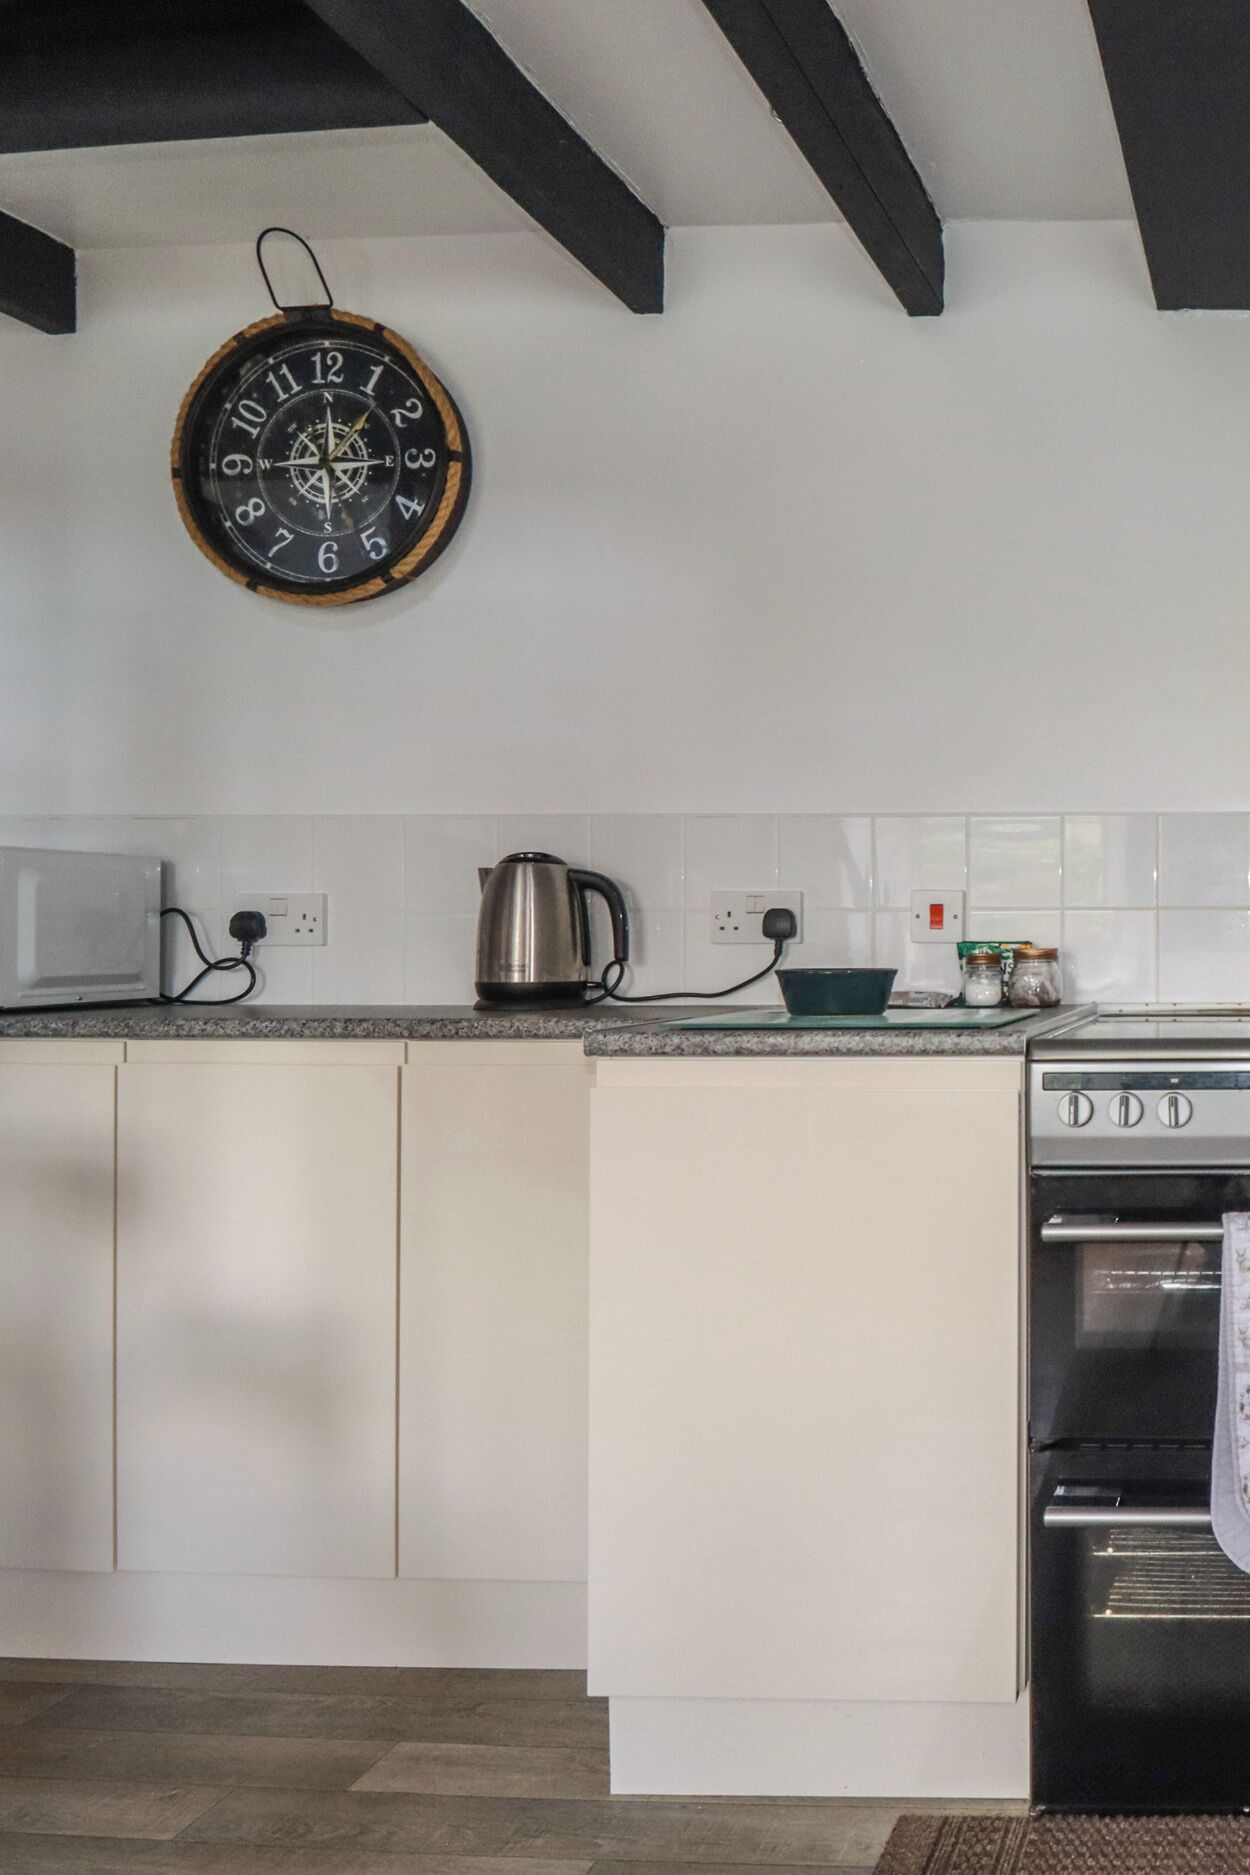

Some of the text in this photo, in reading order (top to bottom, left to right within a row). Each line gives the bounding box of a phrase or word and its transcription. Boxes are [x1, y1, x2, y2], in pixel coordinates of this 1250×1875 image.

[311, 351, 344, 384] 12
[360, 365, 384, 396] 1
[266, 363, 303, 402] 11
[323, 392, 333, 403] N
[232, 399, 267, 439] 10
[390, 398, 424, 428] 2
[222, 453, 253, 477] 9
[259, 458, 273, 470] W
[385, 456, 395, 468] E
[404, 448, 436, 470] 3
[235, 497, 266, 526] 8
[395, 494, 426, 521] 4
[268, 527, 294, 558] 7
[324, 522, 332, 534] S
[317, 541, 340, 573] 6
[360, 526, 388, 560] 5
